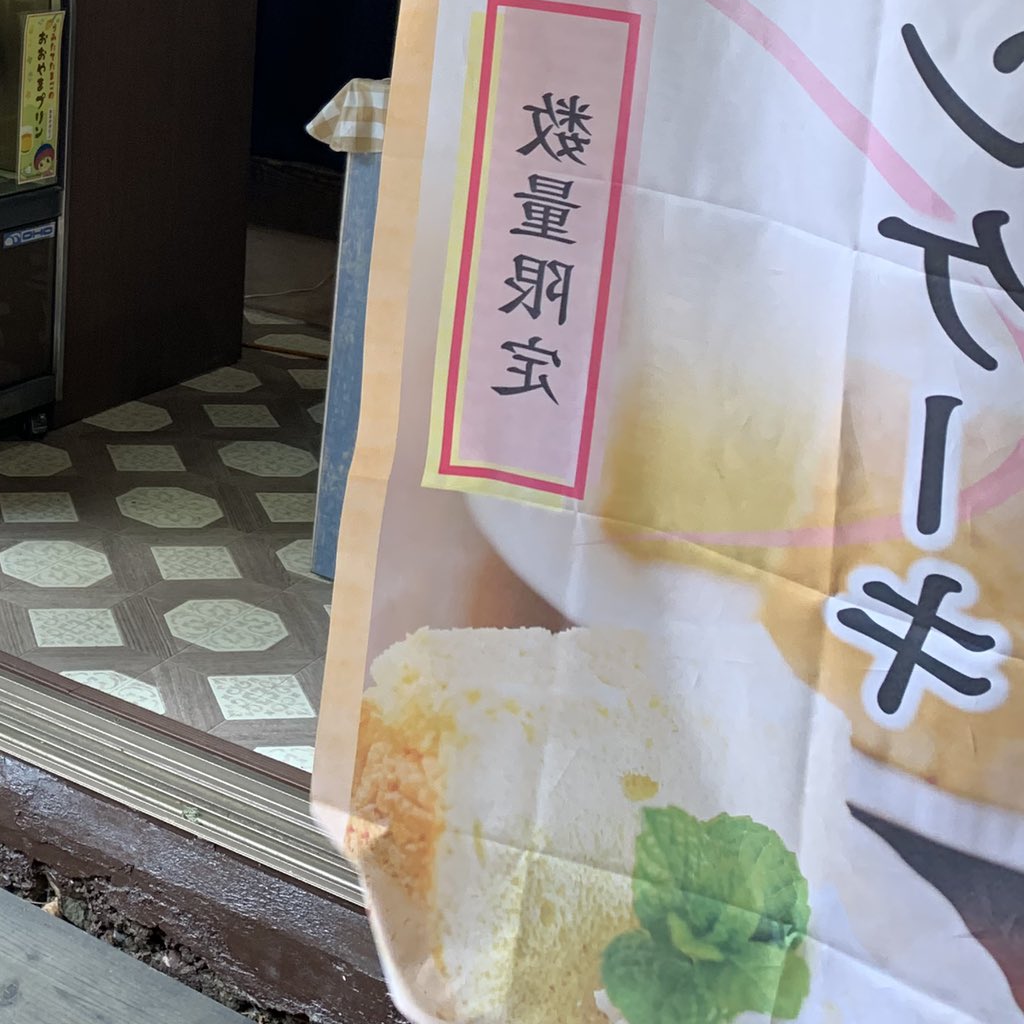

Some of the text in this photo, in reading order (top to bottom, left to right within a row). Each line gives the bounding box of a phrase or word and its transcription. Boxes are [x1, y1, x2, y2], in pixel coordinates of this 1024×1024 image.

[35, 31, 49, 139] おおやまプリン
